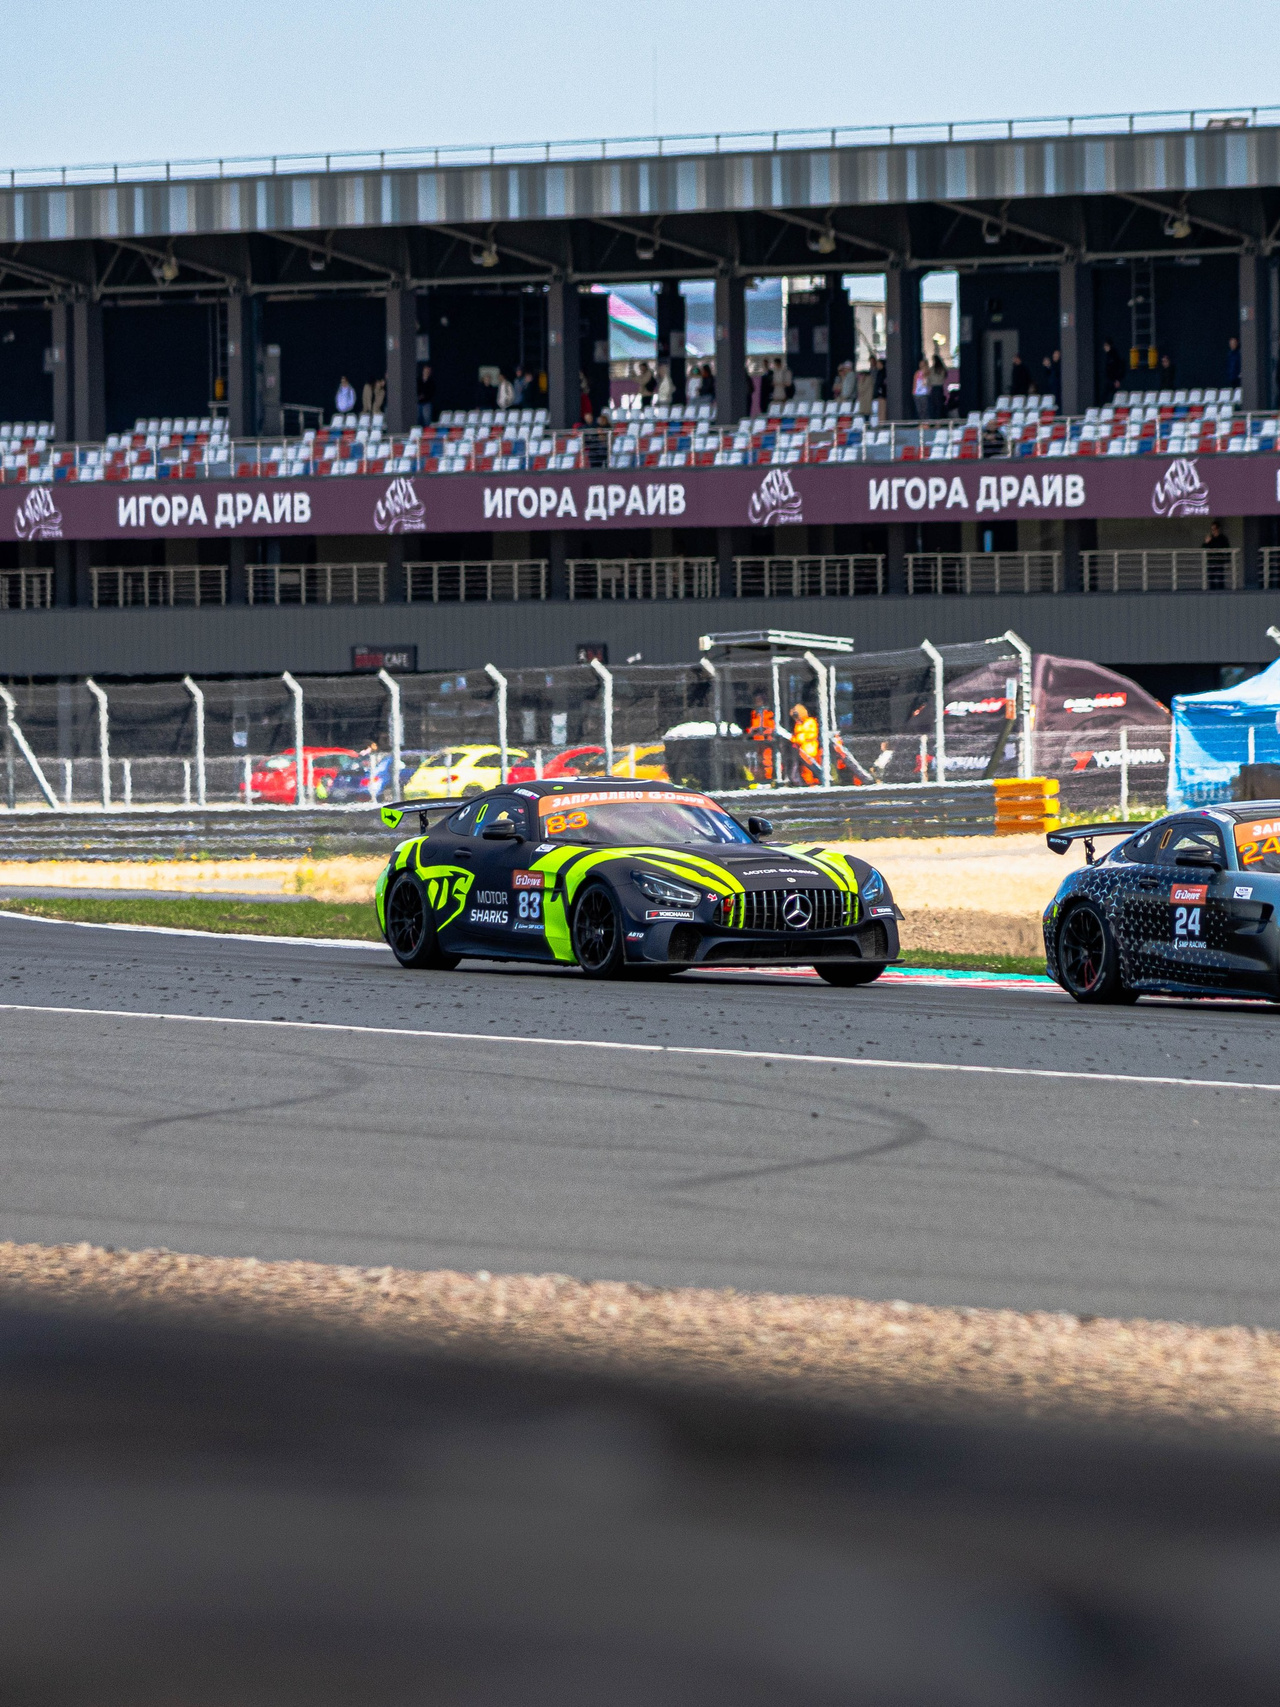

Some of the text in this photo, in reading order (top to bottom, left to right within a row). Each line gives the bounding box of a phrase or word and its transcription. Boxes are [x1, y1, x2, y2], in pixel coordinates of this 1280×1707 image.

[483, 483, 686, 522] ИГОРА ДРАЙВ
[868, 474, 1086, 513] ИГОРА ДРАЙВ
[118, 492, 312, 530] ИГОРА ДРАЙВ
[552, 791, 643, 808] ЗАПРАВЛЕНО
[546, 811, 589, 835] 83
[743, 868, 819, 876] MOTOR SHARKS
[476, 890, 508, 905] MOTOR
[518, 891, 541, 918] 83
[470, 909, 509, 924] SHARKS
[1175, 906, 1201, 936] 24
